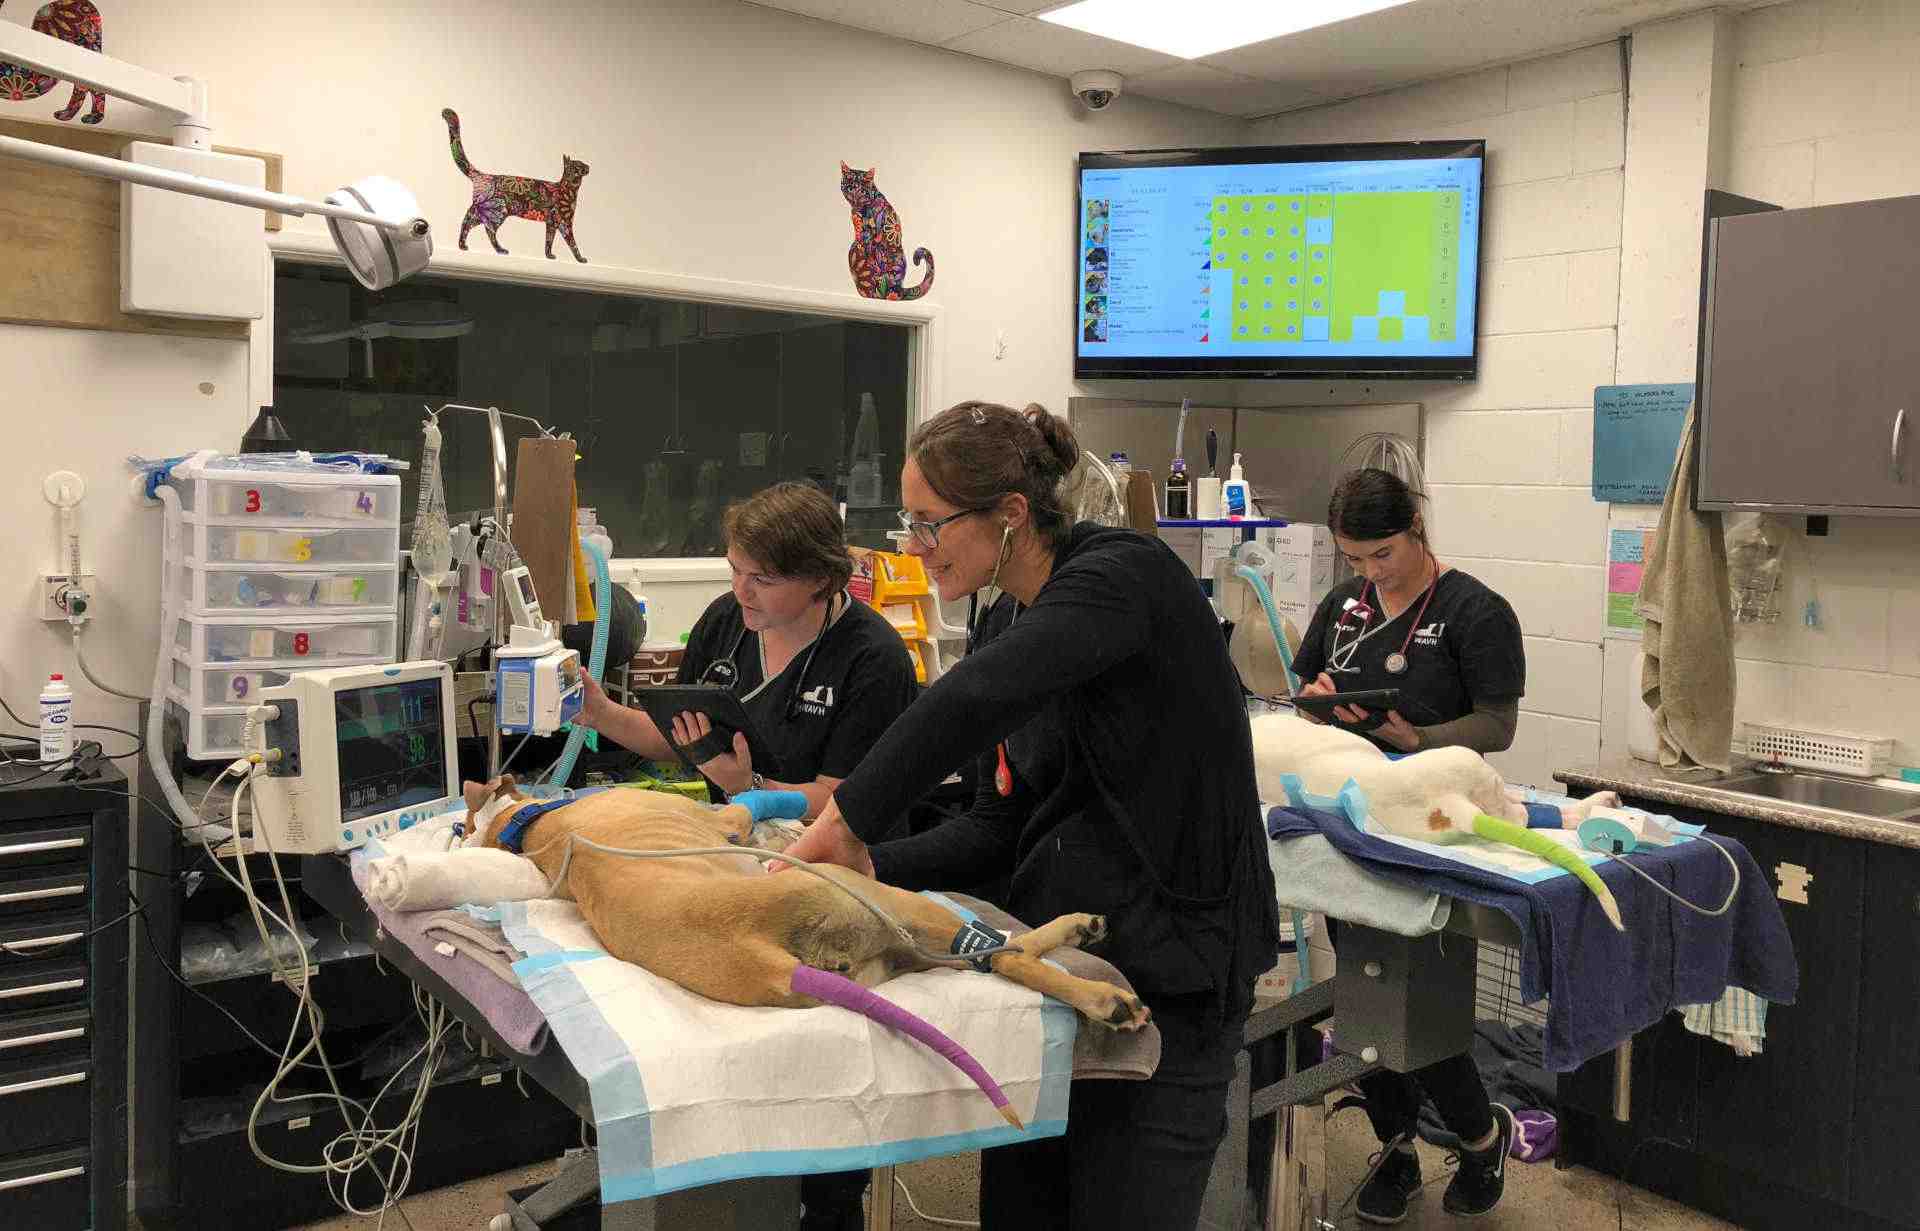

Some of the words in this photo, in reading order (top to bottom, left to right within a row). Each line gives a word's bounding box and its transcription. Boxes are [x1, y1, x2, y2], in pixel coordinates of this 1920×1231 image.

[245, 489, 262, 512] 3
[356, 491, 373, 513] 4
[296, 537, 312, 561] 5
[352, 576, 367, 600] 7
[294, 632, 310, 656] 8
[232, 676, 249, 699] 9
